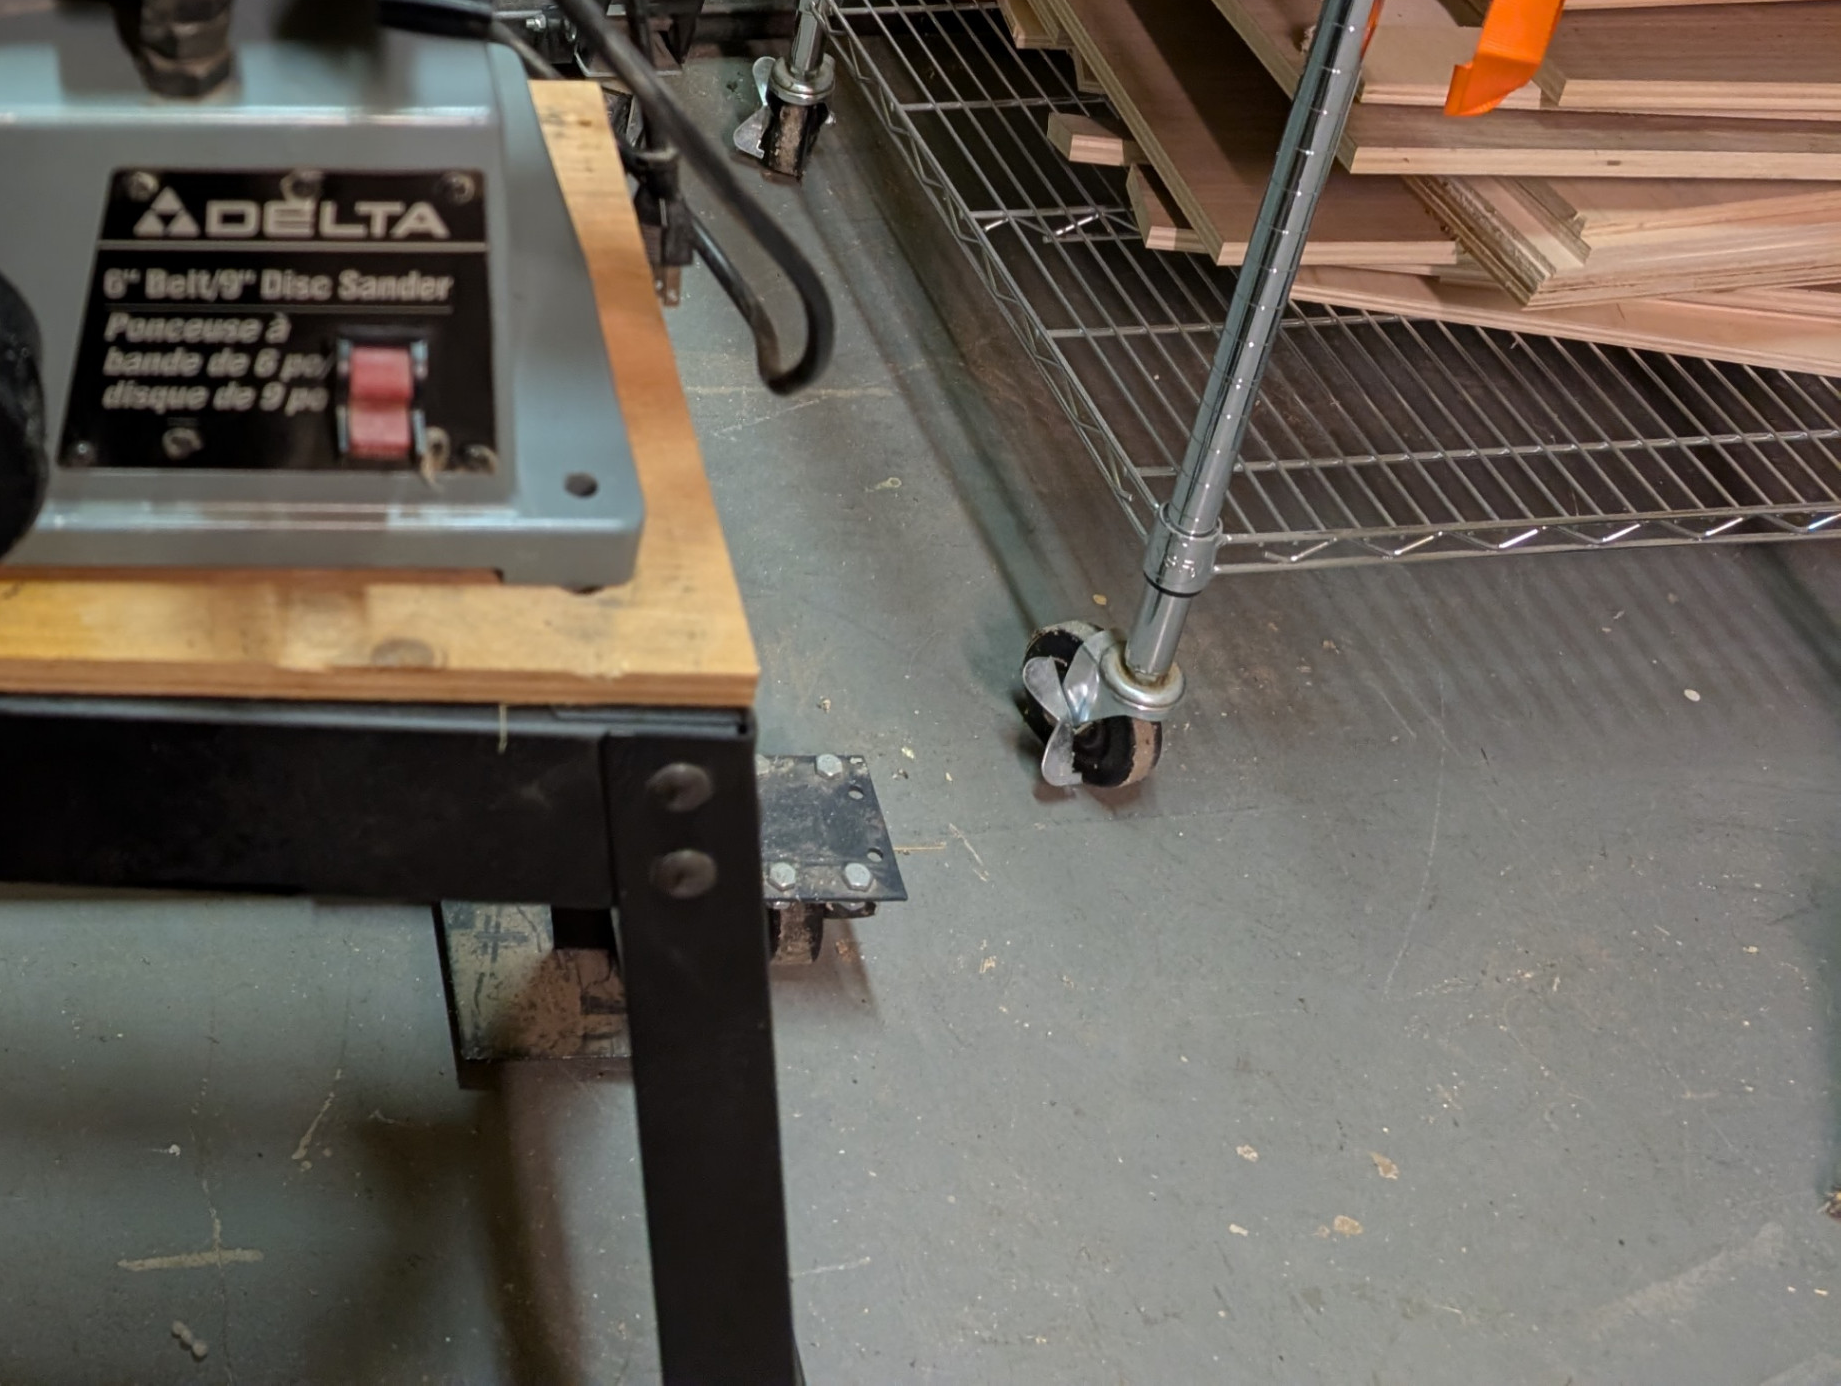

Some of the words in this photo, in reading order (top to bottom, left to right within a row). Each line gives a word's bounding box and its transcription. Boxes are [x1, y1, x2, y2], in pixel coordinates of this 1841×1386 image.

[205, 200, 451, 240] DELTA
[261, 267, 333, 302] Disc
[338, 268, 455, 302] Sander
[104, 312, 263, 344] Ponceuse
[265, 311, 292, 345] à
[102, 346, 204, 377] bande
[206, 347, 251, 377] de
[253, 347, 281, 378] 6
[101, 380, 210, 415] disque
[212, 380, 256, 411] de
[259, 381, 287, 412] 9
[284, 385, 330, 416] po
